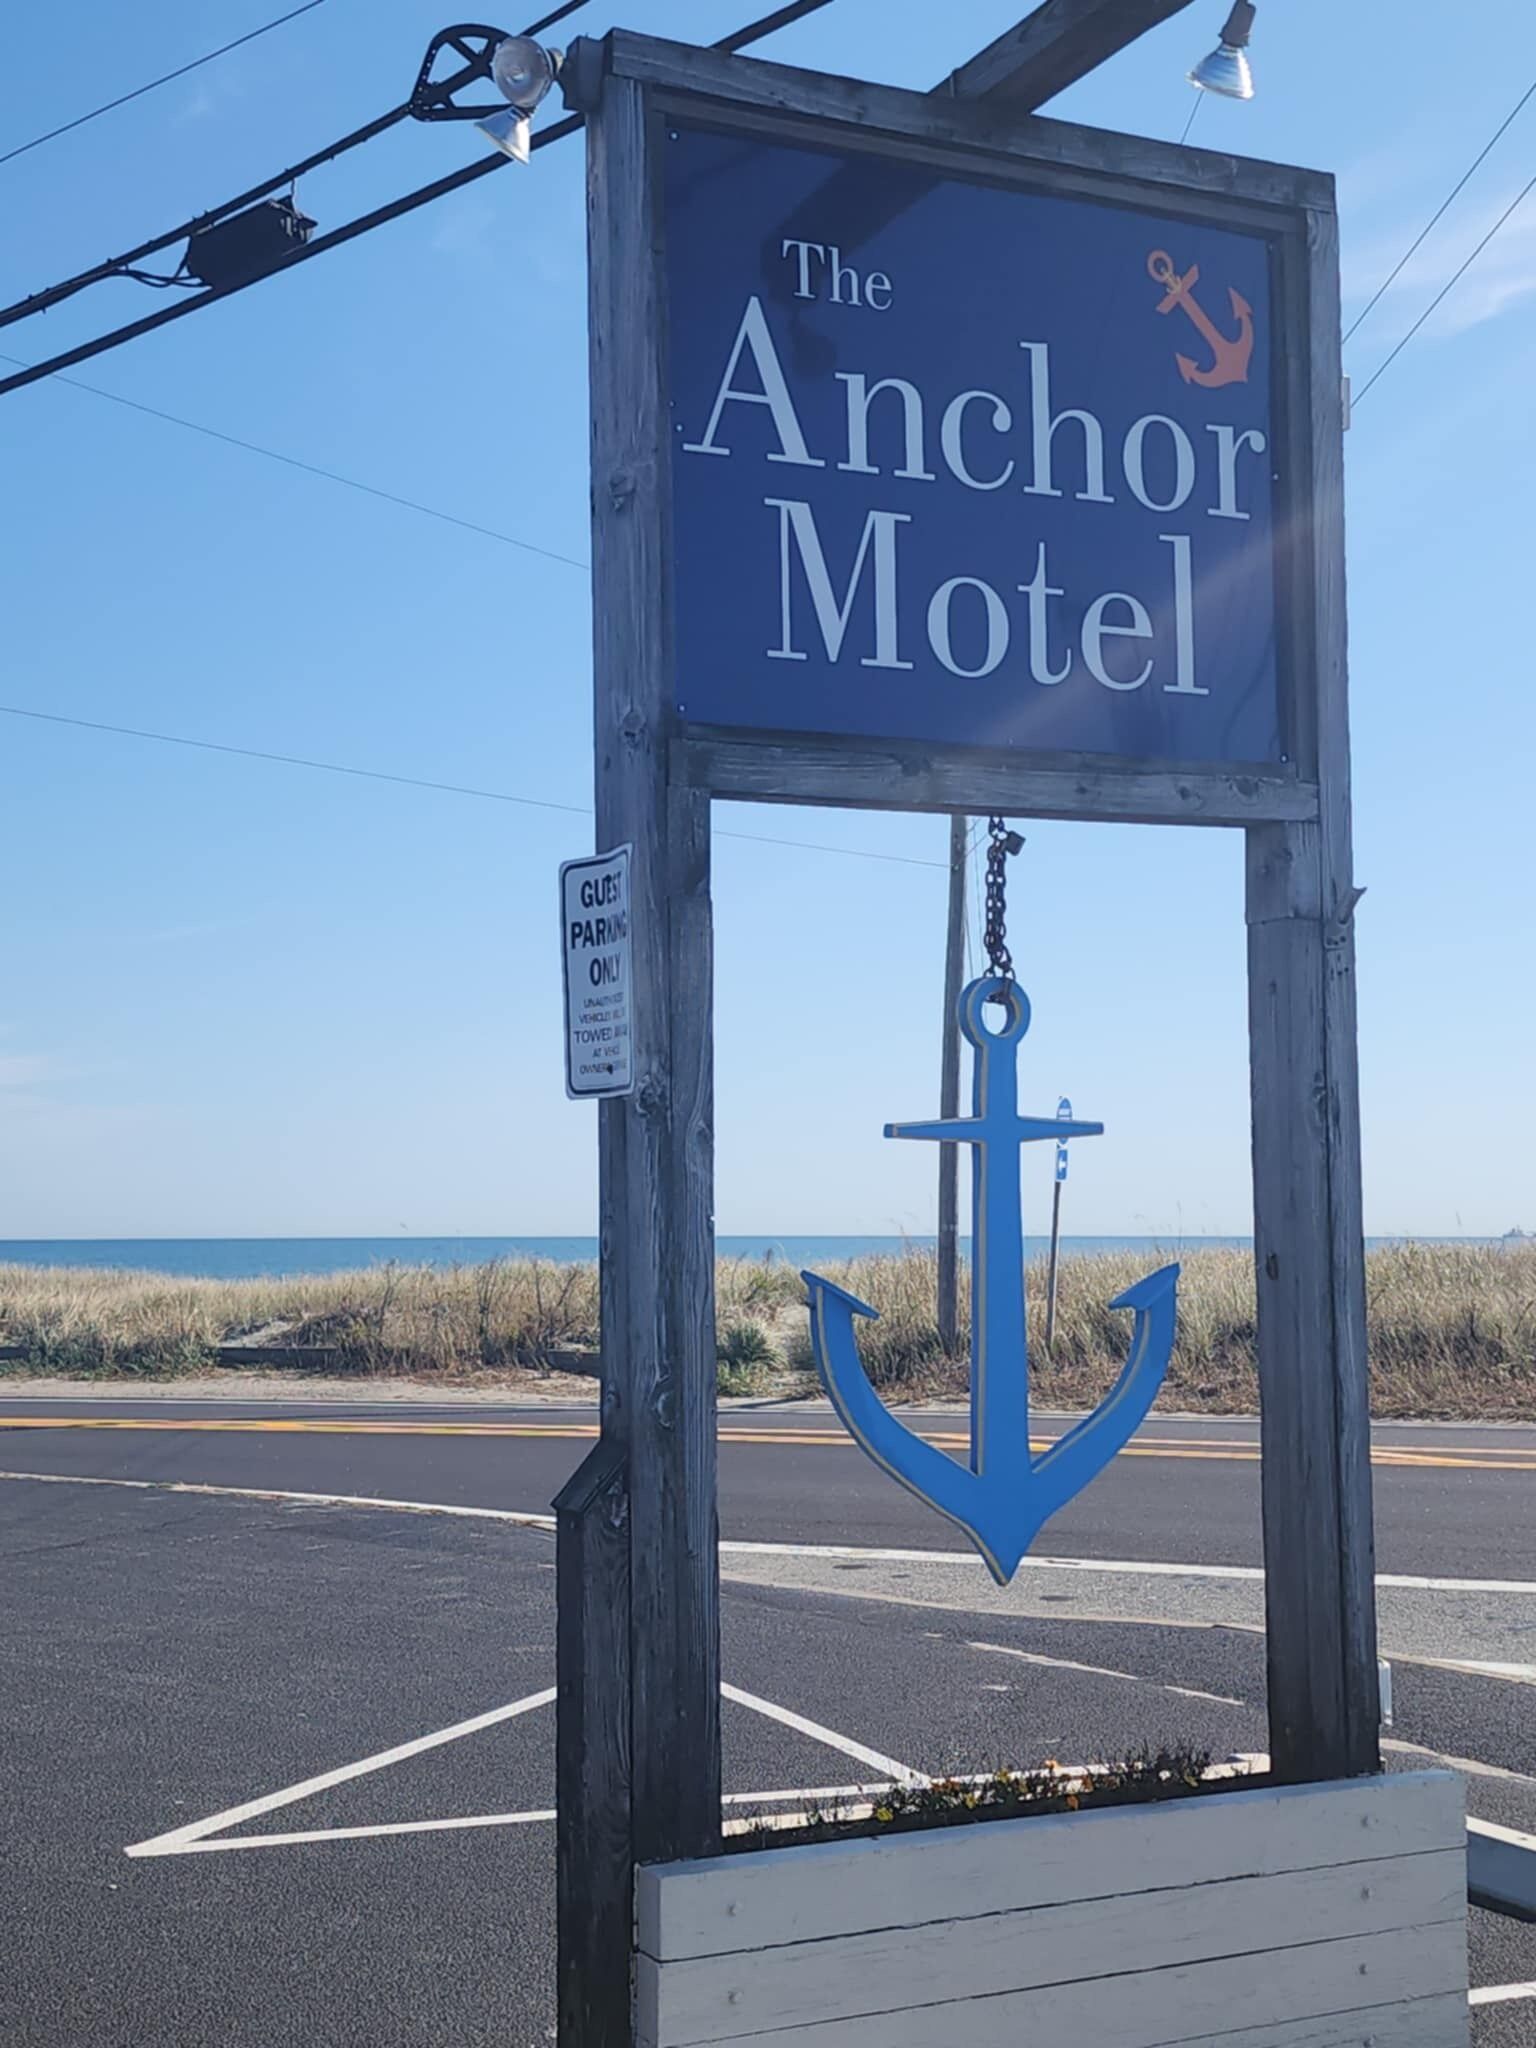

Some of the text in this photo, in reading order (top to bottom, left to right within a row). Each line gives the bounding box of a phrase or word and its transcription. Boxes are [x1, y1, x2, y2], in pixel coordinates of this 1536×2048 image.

[783, 239, 893, 310] The
[684, 297, 1266, 520] Anchor
[764, 499, 1209, 695] Motel
[580, 871, 621, 909] GUEST
[570, 909, 627, 950] PARKING
[589, 952, 621, 987] ONLY
